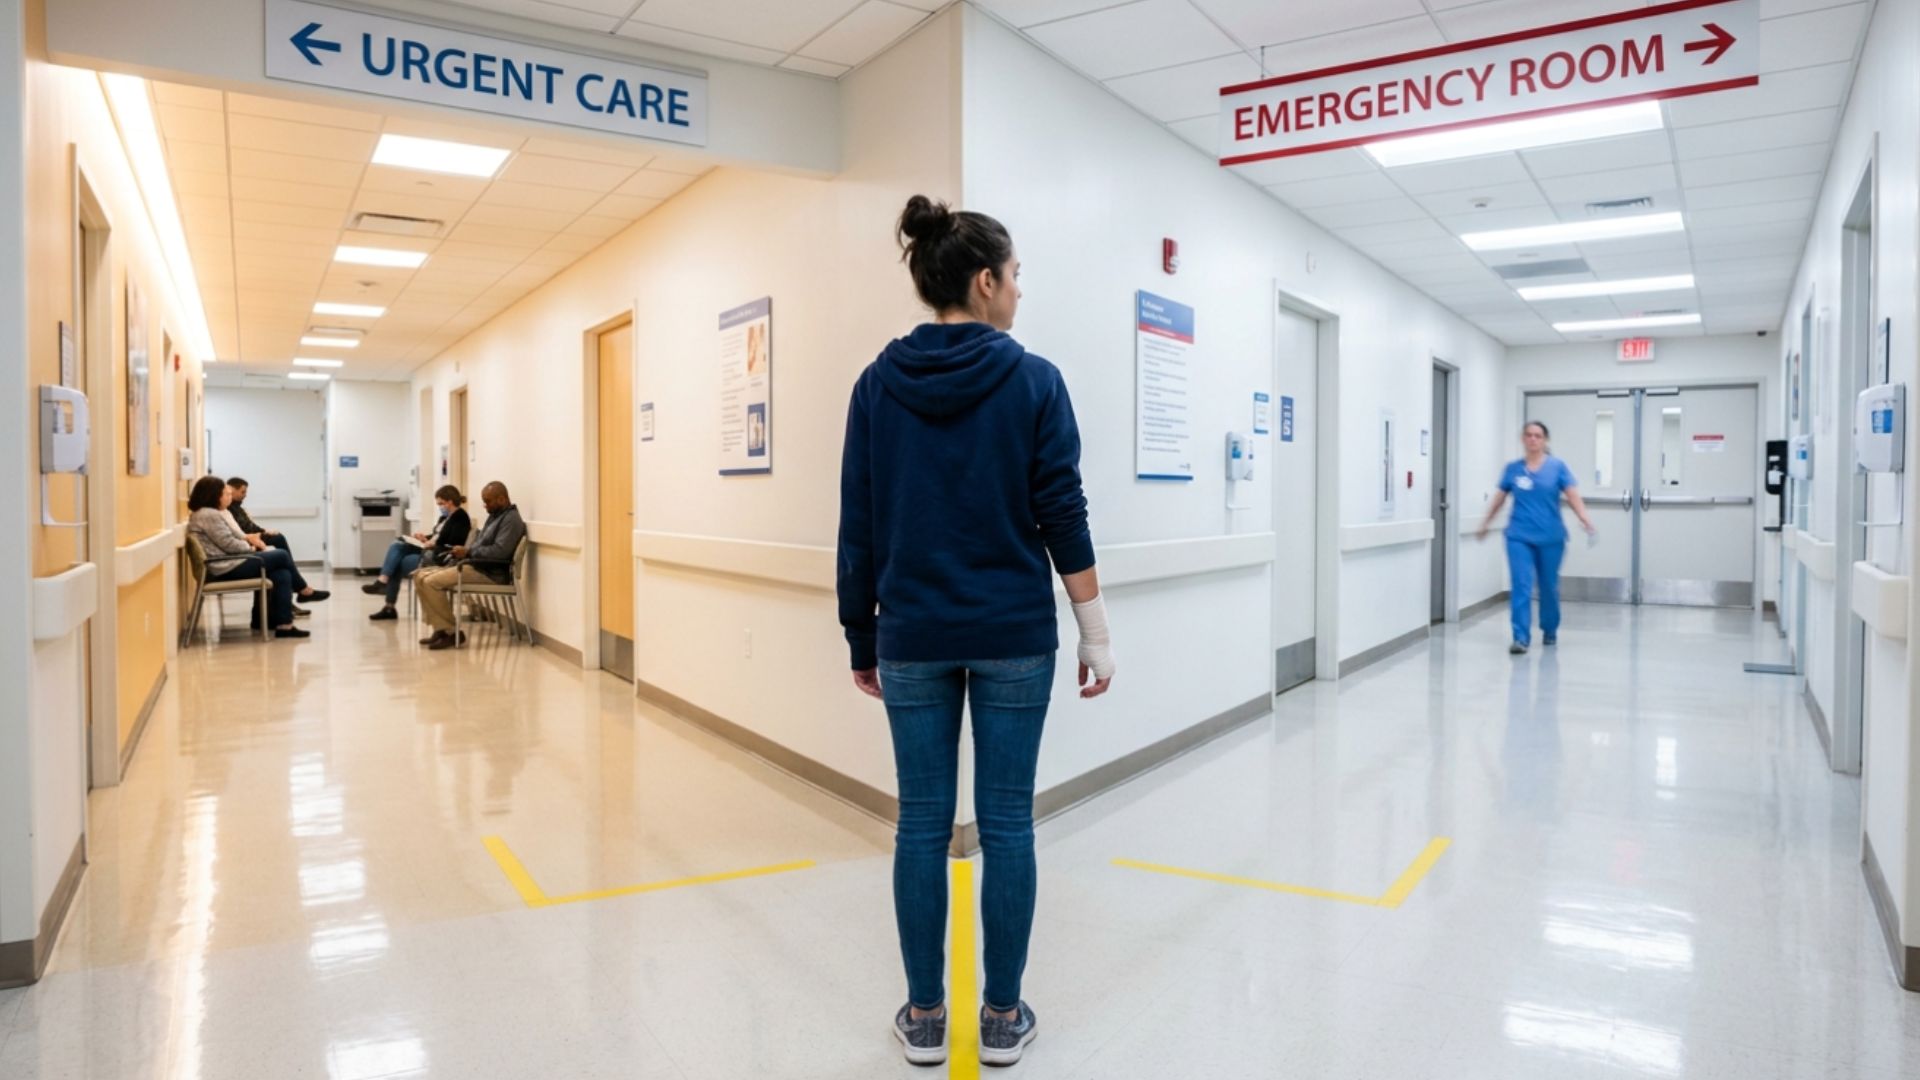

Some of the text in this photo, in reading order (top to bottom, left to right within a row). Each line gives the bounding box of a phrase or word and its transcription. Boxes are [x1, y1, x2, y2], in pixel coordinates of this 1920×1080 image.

[362, 33, 690, 127] URGENT CARE
[1234, 34, 1665, 141] EMERGENCY ROOM
